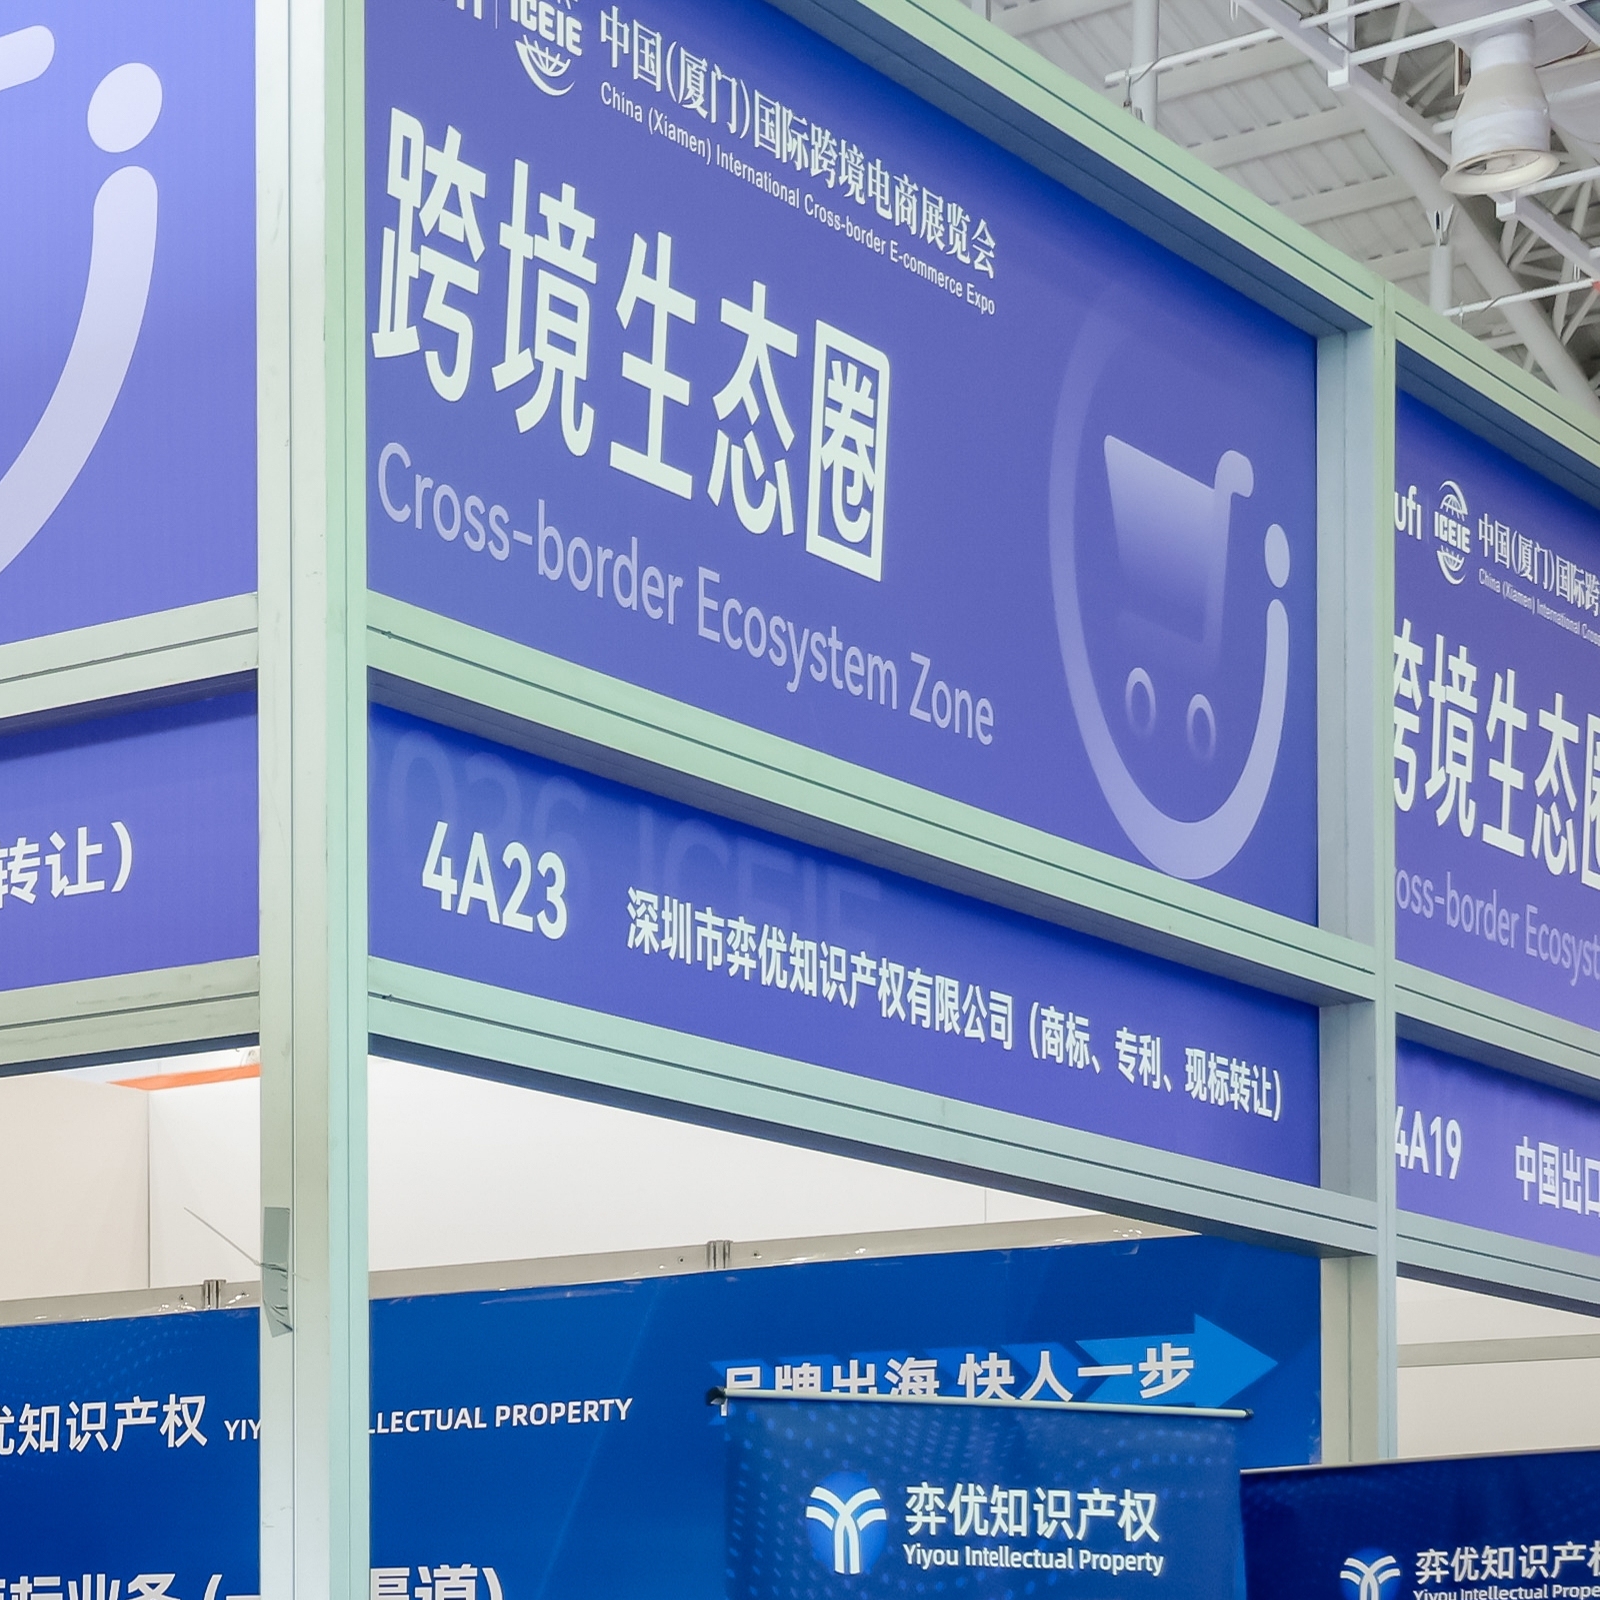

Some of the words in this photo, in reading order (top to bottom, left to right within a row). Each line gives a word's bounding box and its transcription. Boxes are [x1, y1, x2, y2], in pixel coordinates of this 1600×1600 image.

[601, 5, 996, 279] 中国(厦门)国际跨境电商展览会
[601, 80, 643, 124] China
[648, 106, 711, 166] (Xiamen)
[716, 143, 800, 210] International
[804, 193, 886, 257] Cross-border
[889, 240, 963, 299] E-commerce
[966, 283, 995, 316] Expo
[371, 107, 890, 583] 跨境生态圈
[1435, 512, 1470, 554] ICEIE
[377, 441, 684, 626] Cross-border
[697, 565, 900, 713] Ecosystem
[909, 651, 995, 746] Zone
[421, 819, 568, 941] 4A23
[958, 1342, 1196, 1401] 快人一步
[224, 1418, 262, 1441] YIY
[369, 1406, 487, 1434] LECTUAL
[495, 1397, 634, 1428] PROPERTY
[904, 1481, 1161, 1543] 弈优知识产权
[903, 1543, 958, 1570] Yiyou
[965, 1543, 1074, 1571] Intellectual
[1079, 1548, 1165, 1577] Property
